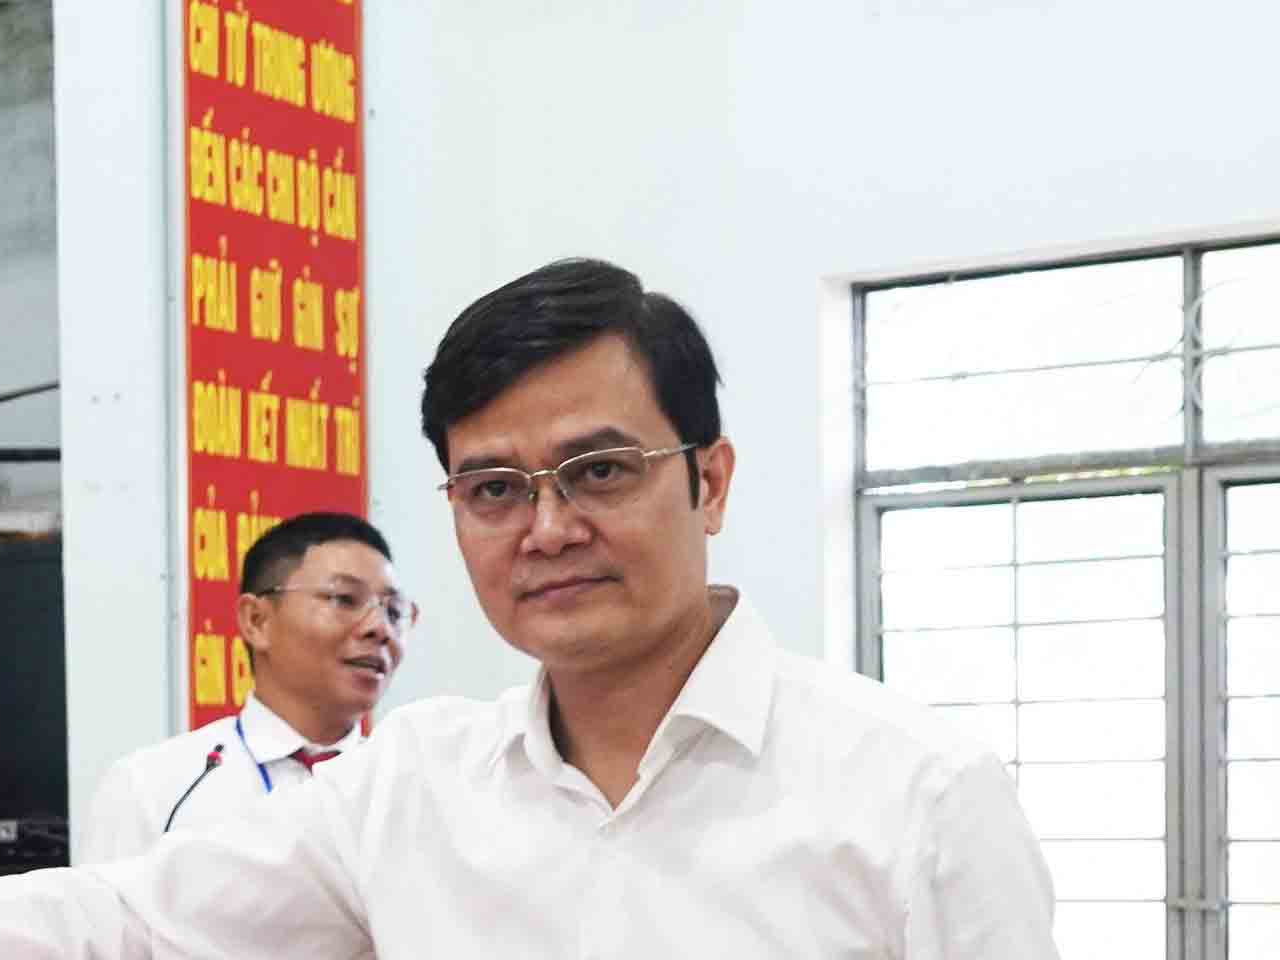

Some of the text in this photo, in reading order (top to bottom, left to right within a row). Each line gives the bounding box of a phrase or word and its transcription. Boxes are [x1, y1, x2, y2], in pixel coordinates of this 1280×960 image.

[251, 20, 306, 108] TRUNG
[229, 127, 264, 216] CÁC
[248, 370, 280, 463] KẾT
[285, 377, 329, 471] NHẤT
